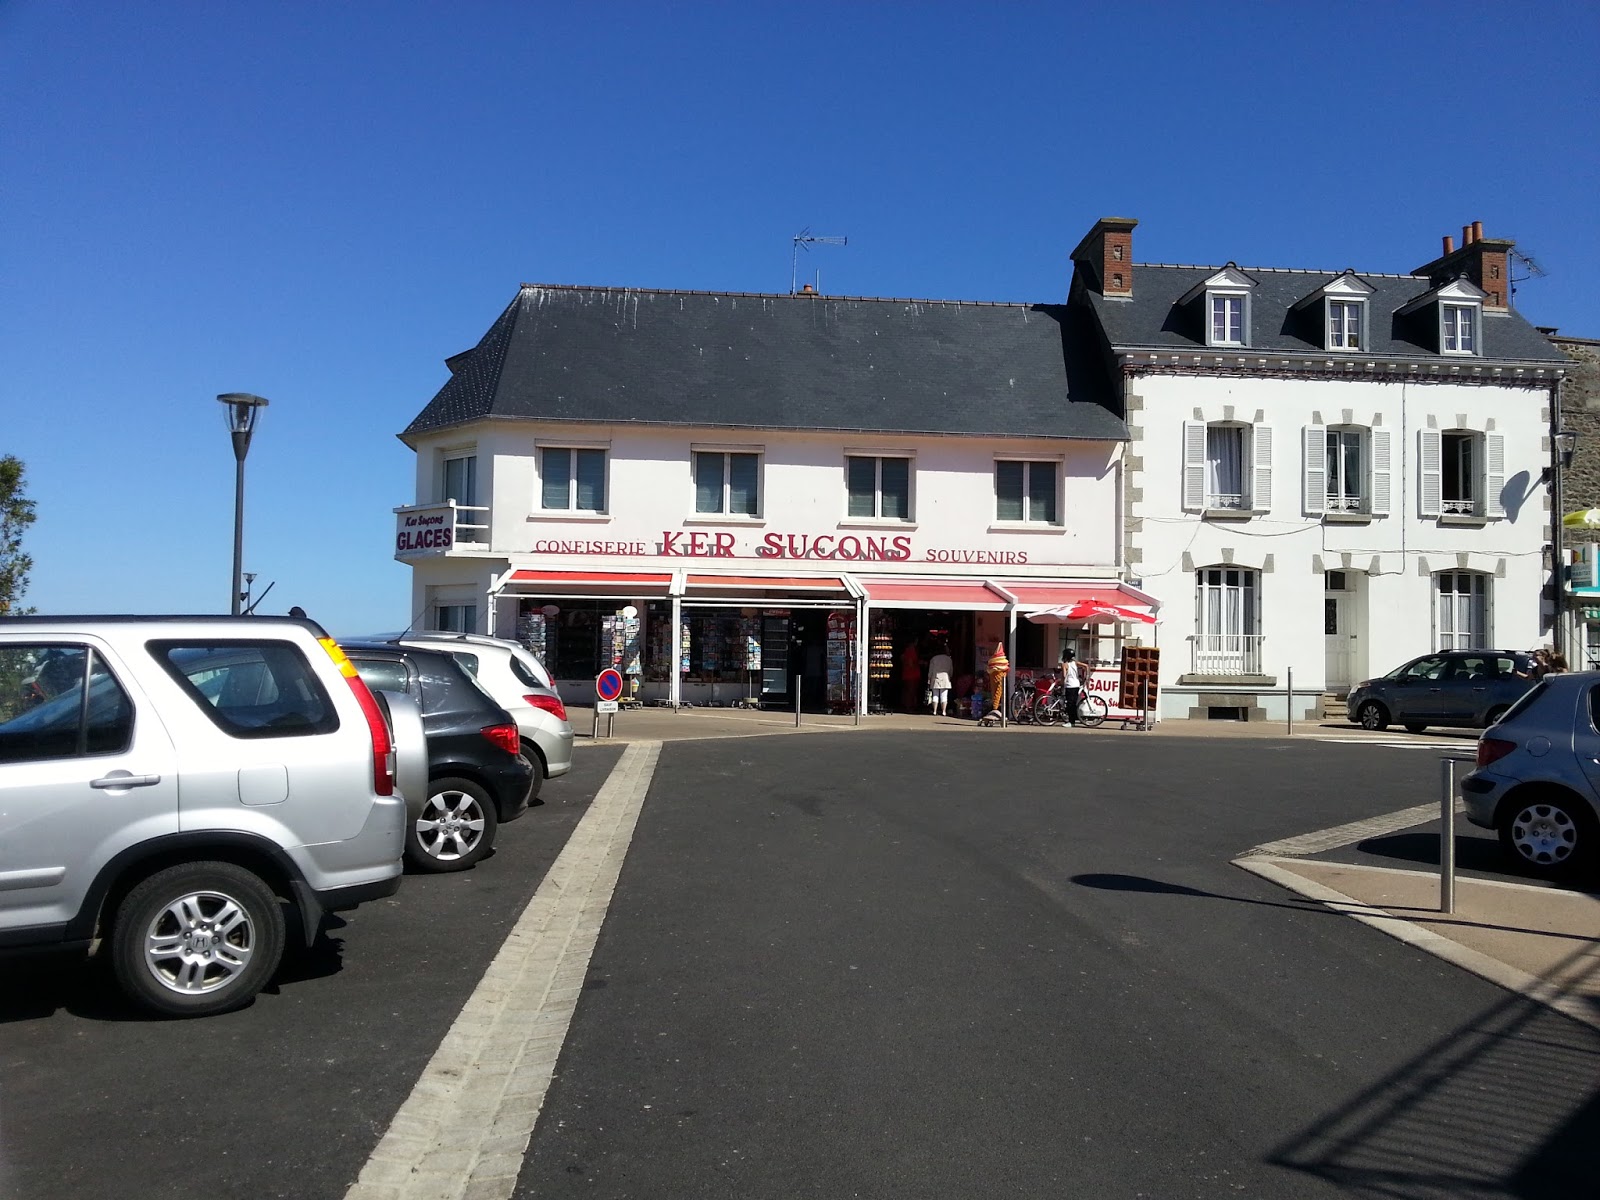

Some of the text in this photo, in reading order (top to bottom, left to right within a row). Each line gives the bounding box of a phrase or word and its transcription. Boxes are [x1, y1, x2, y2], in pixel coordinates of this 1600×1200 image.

[397, 527, 452, 551] GLACES
[535, 540, 646, 555] CONFISERIE
[662, 531, 736, 557] KER
[925, 548, 1028, 564] SOUVENIRS
[1086, 678, 1119, 692] GAUF
